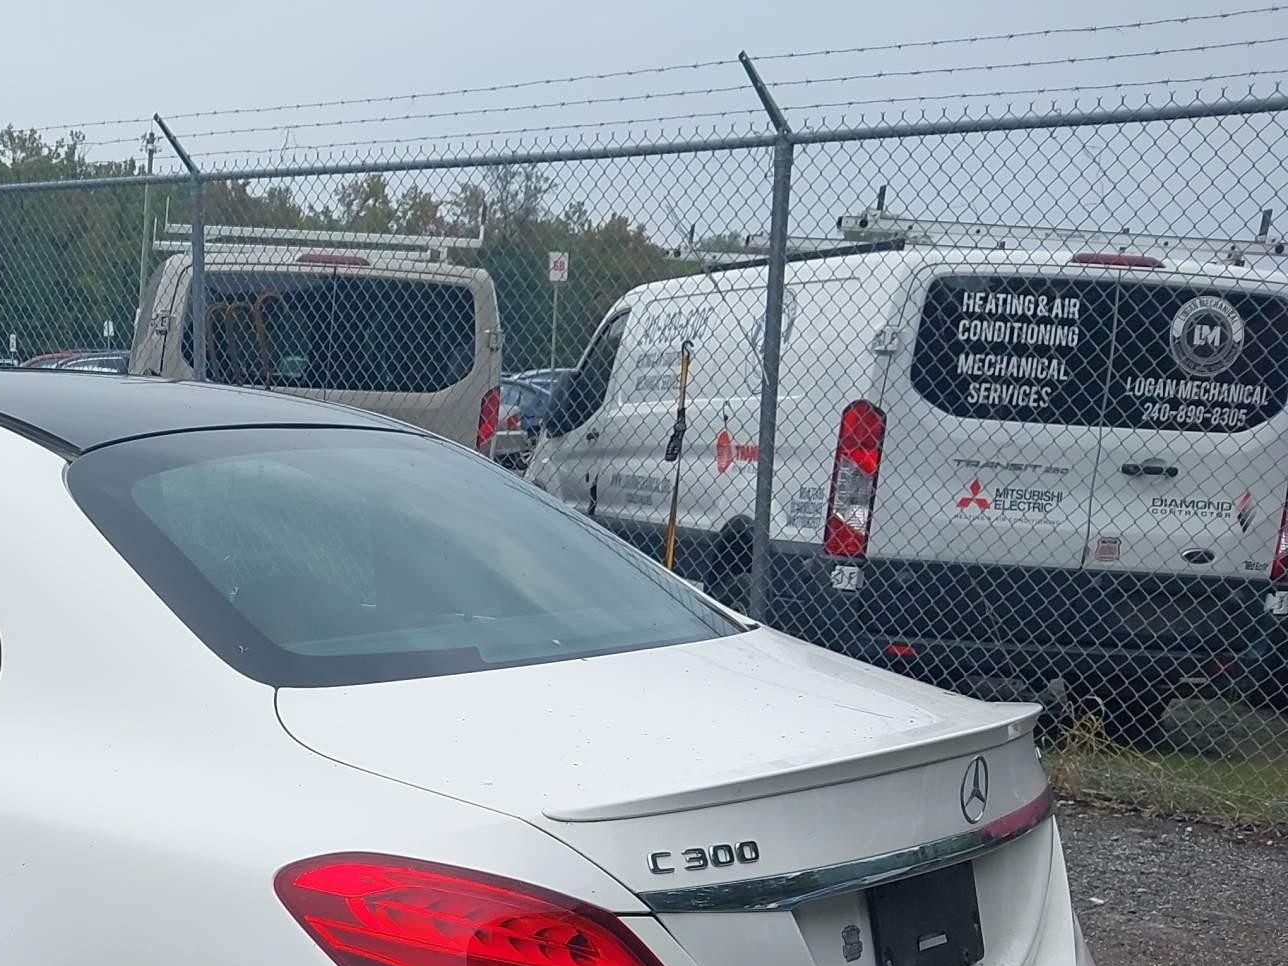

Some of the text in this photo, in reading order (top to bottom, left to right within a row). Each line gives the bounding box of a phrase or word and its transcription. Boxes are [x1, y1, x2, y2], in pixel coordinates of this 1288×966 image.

[962, 291, 1081, 320] HEATING & AIR
[957, 319, 1080, 347] CONDITIONING
[956, 353, 1069, 381] MECHANICAL
[967, 383, 1052, 408] SERVICES
[1125, 376, 1269, 406] LOGAN MECHANICAL
[1141, 402, 1248, 427] 240-899-8305
[735, 445, 760, 461] TRAN
[952, 458, 1042, 473] TRANSIT
[993, 499, 1053, 513] ELECTRIC
[994, 487, 1063, 502] MITSUBISHI
[1151, 497, 1233, 512] DIAMOND
[1150, 508, 1232, 519] CONTRACTOR
[647, 840, 760, 875] C 300
